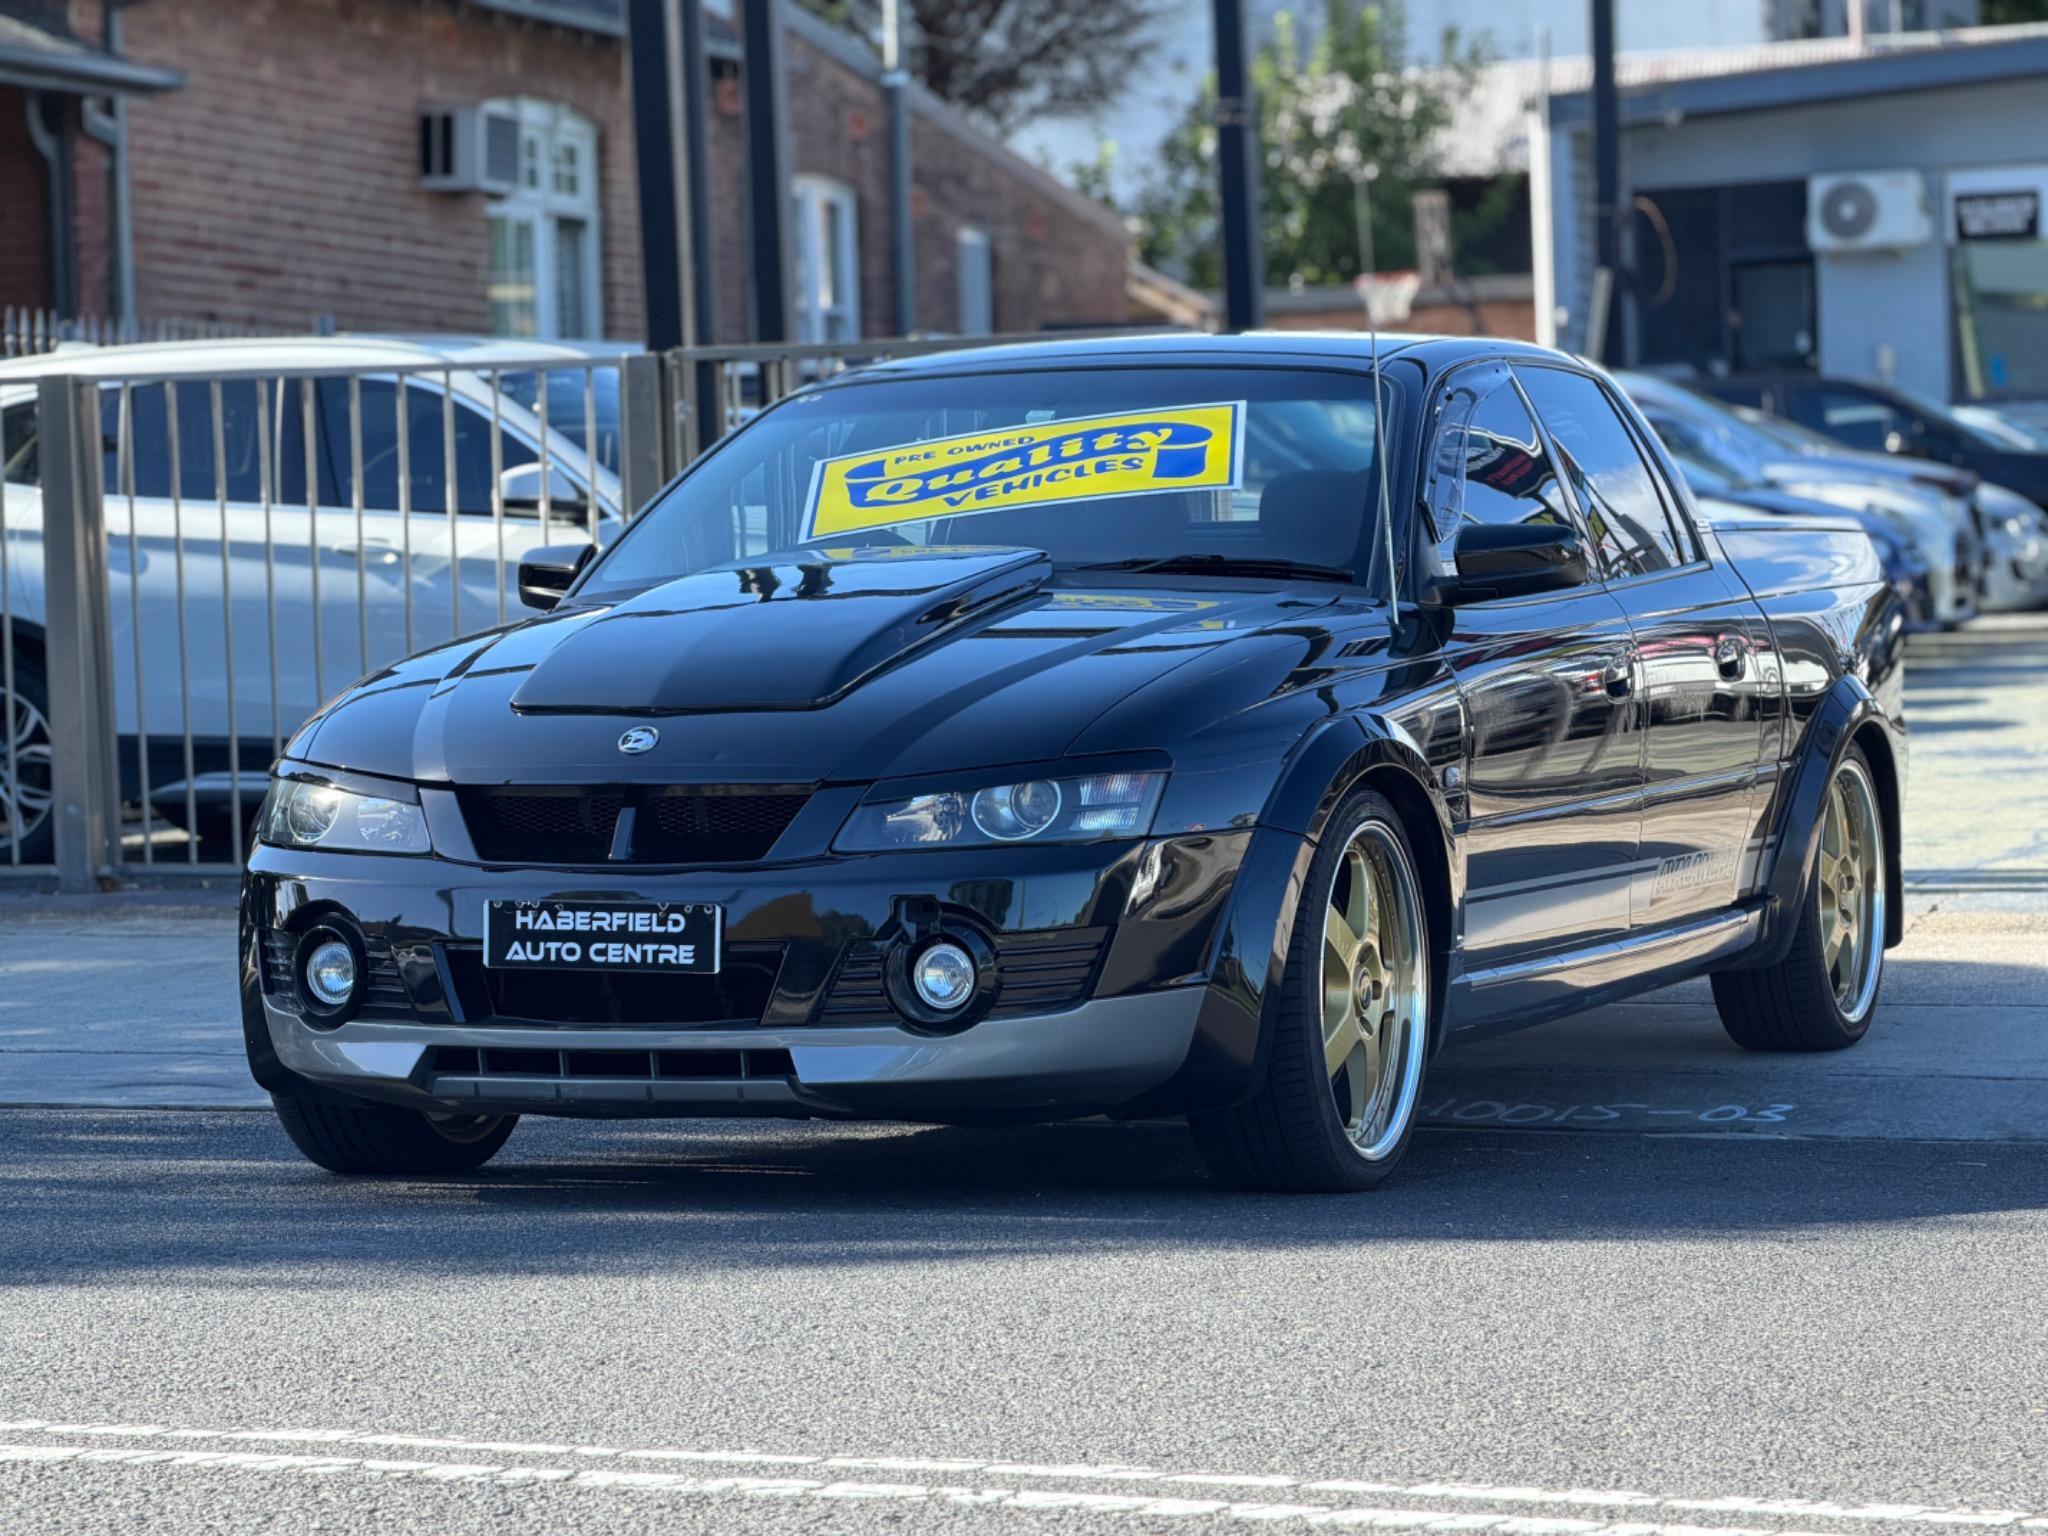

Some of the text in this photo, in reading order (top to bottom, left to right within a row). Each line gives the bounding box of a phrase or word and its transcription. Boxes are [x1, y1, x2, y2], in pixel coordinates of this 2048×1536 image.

[863, 426, 1174, 502] Quality
[894, 435, 1036, 466] PRE OWNED
[943, 456, 1145, 508] VEHICLES
[515, 910, 686, 932] HABERFIELD
[505, 940, 696, 965] AUTO CENTRE
